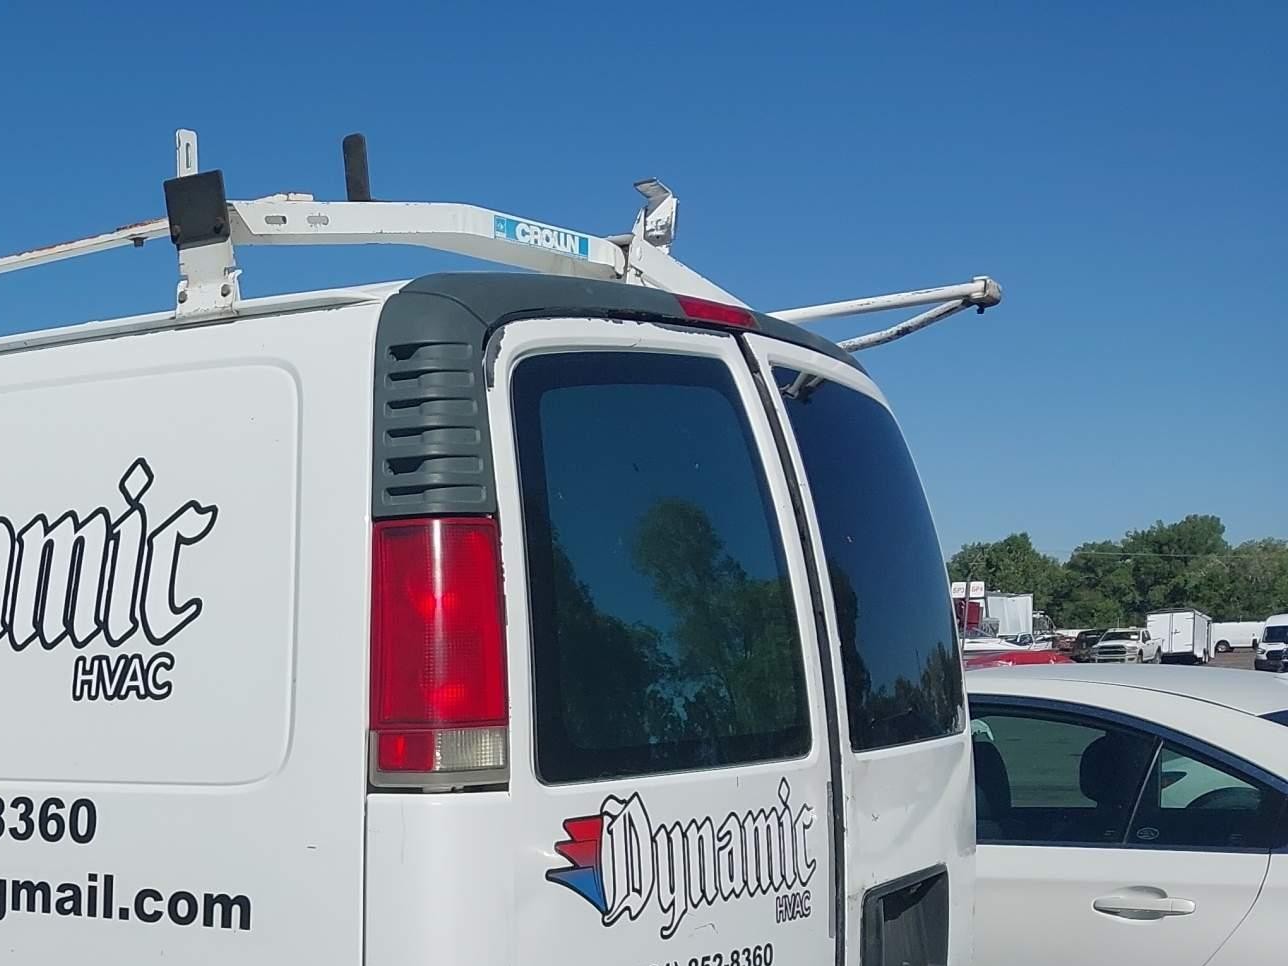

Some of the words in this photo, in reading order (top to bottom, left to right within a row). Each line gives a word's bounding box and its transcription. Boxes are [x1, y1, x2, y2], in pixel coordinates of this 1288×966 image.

[515, 222, 580, 255] CROWN
[72, 652, 175, 701] HVAC
[602, 777, 816, 939] Dynamic
[775, 890, 812, 924] HVAC
